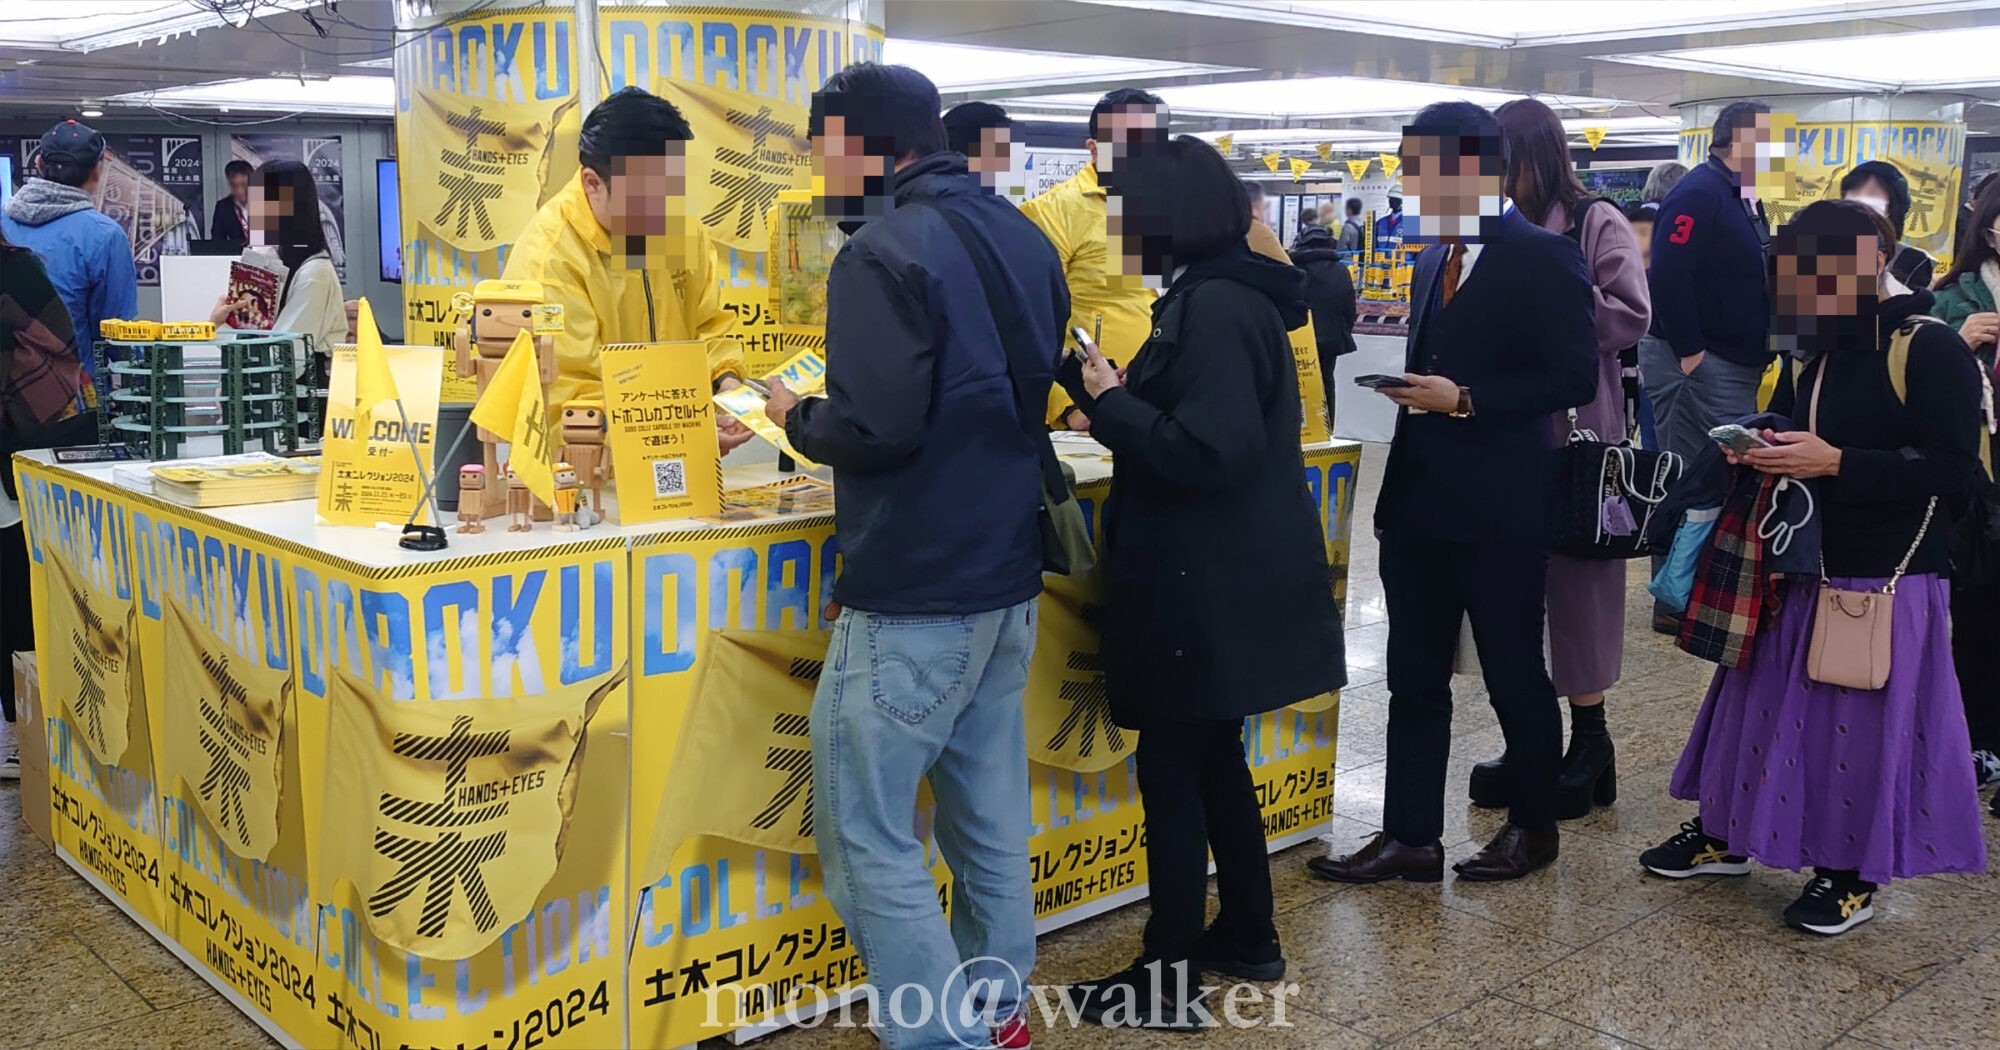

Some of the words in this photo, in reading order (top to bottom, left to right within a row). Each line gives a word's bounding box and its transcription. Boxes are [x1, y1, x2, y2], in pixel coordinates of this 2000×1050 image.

[174, 158, 200, 168] 2024
[315, 158, 340, 168] 2024
[472, 150, 529, 166] HANDS+EYES
[1669, 215, 1695, 245] 3
[612, 403, 710, 425] ドボコレカプセルトイ
[620, 387, 697, 403] アンケートに答えて
[331, 418, 432, 444] WCOME
[293, 560, 613, 701] DOBOKU
[458, 770, 545, 808] HANDS+EYES
[1254, 762, 1335, 810] コレクショ
[52, 783, 160, 888] 土木コレクション2024
[79, 837, 127, 897] HANDS+EYES
[1034, 860, 1136, 916] HANDS+EYES
[170, 872, 316, 1010] 土木コレクション2024
[206, 937, 272, 1013] HANDS+EYES
[644, 923, 854, 1008] 土木コレクショ
